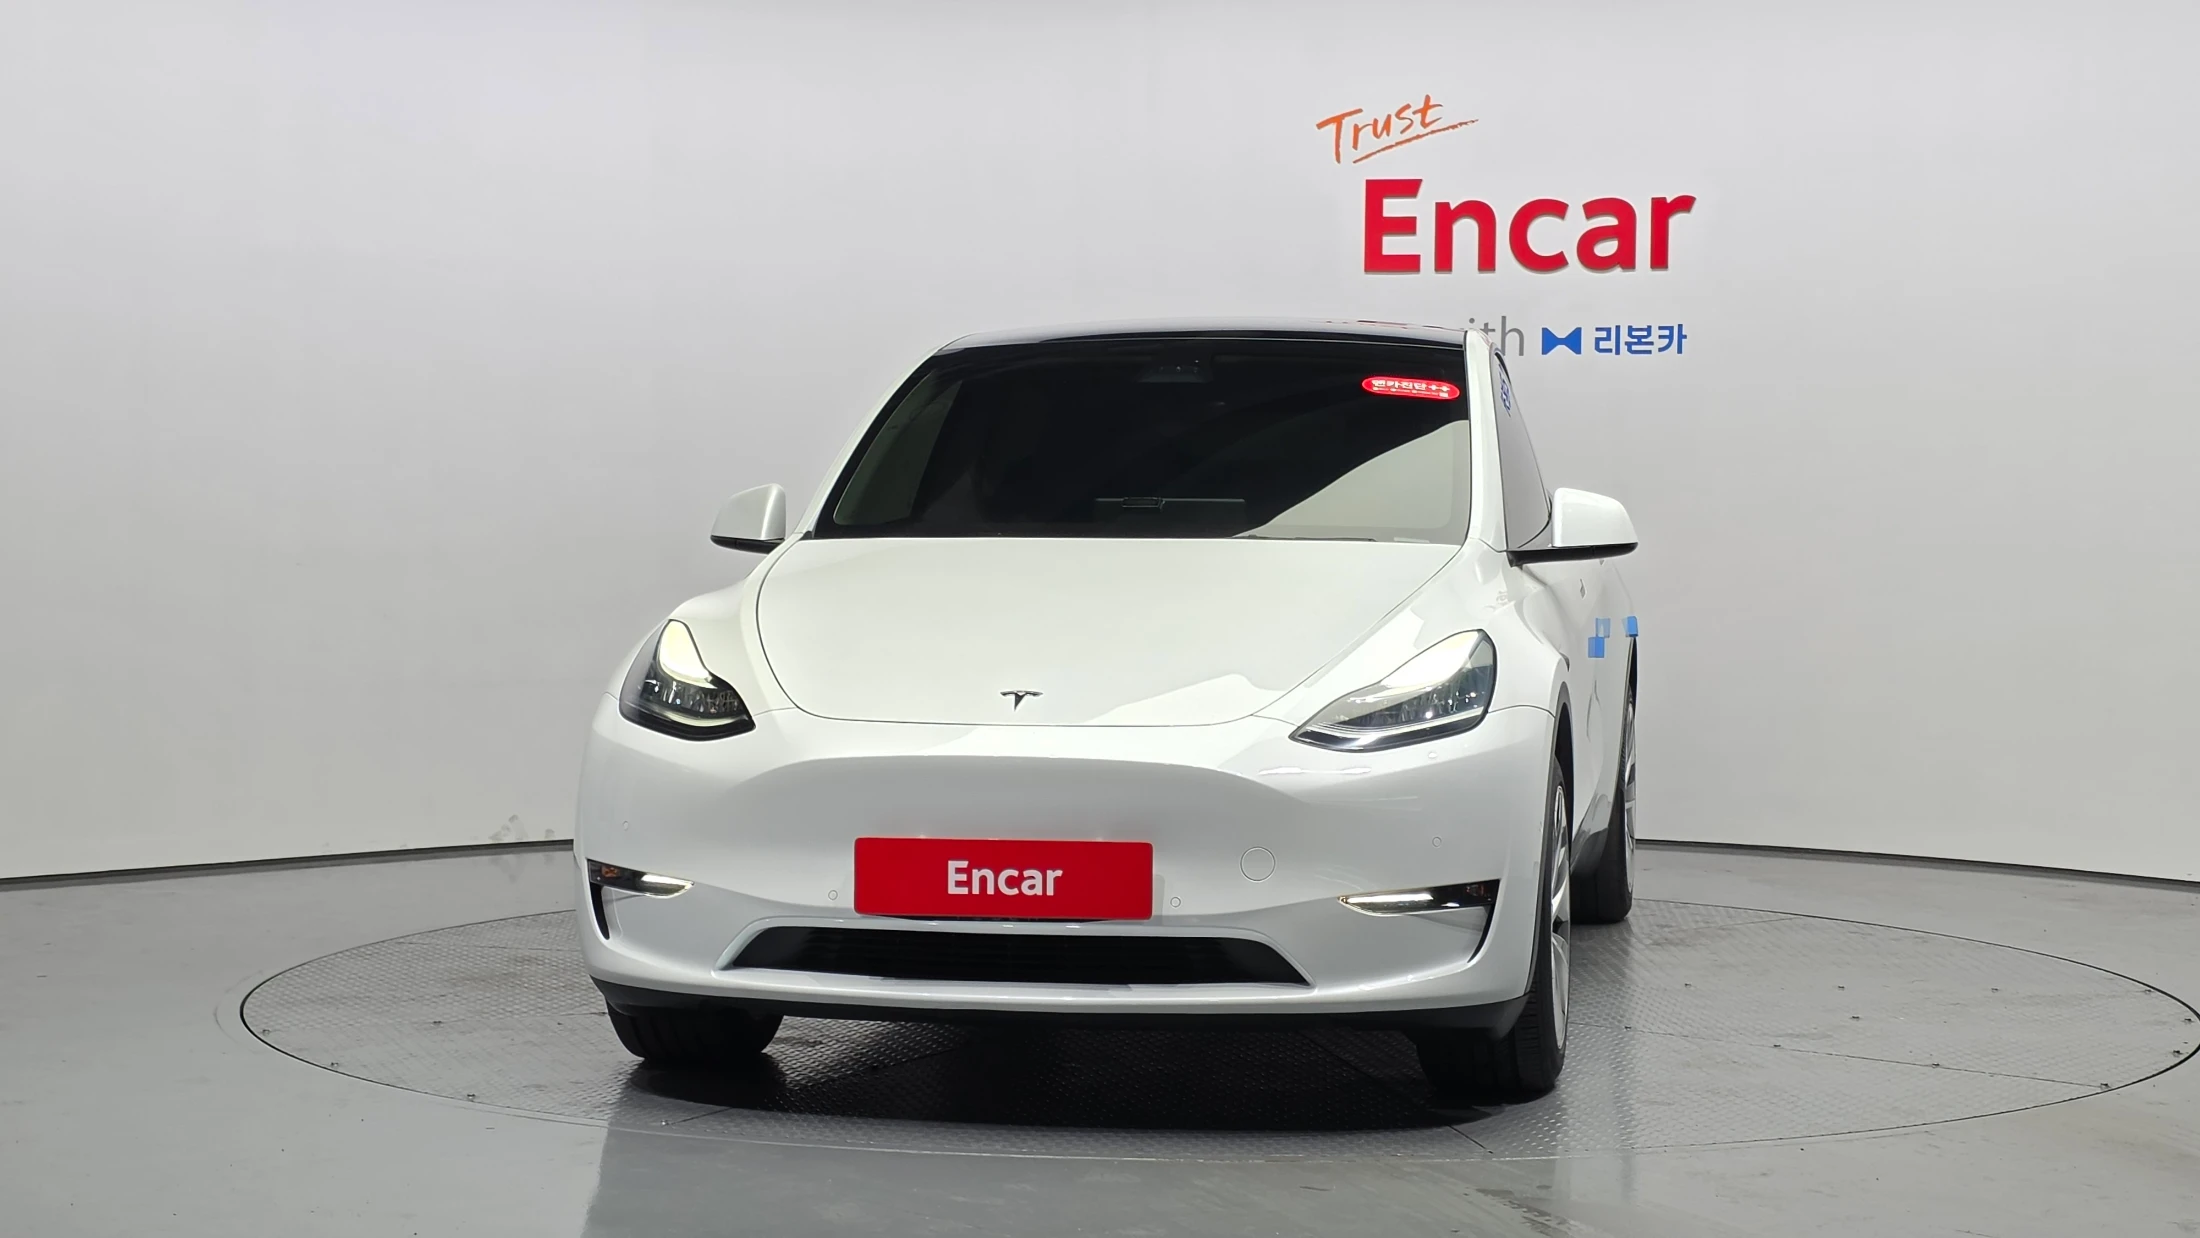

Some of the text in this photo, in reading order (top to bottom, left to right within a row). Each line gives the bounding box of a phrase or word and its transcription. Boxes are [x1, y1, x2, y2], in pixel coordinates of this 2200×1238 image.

[1316, 94, 1444, 163] Trust
[1363, 178, 1698, 274] Encar
[1593, 323, 1688, 357] 리본카
[946, 859, 1064, 897] Encar
